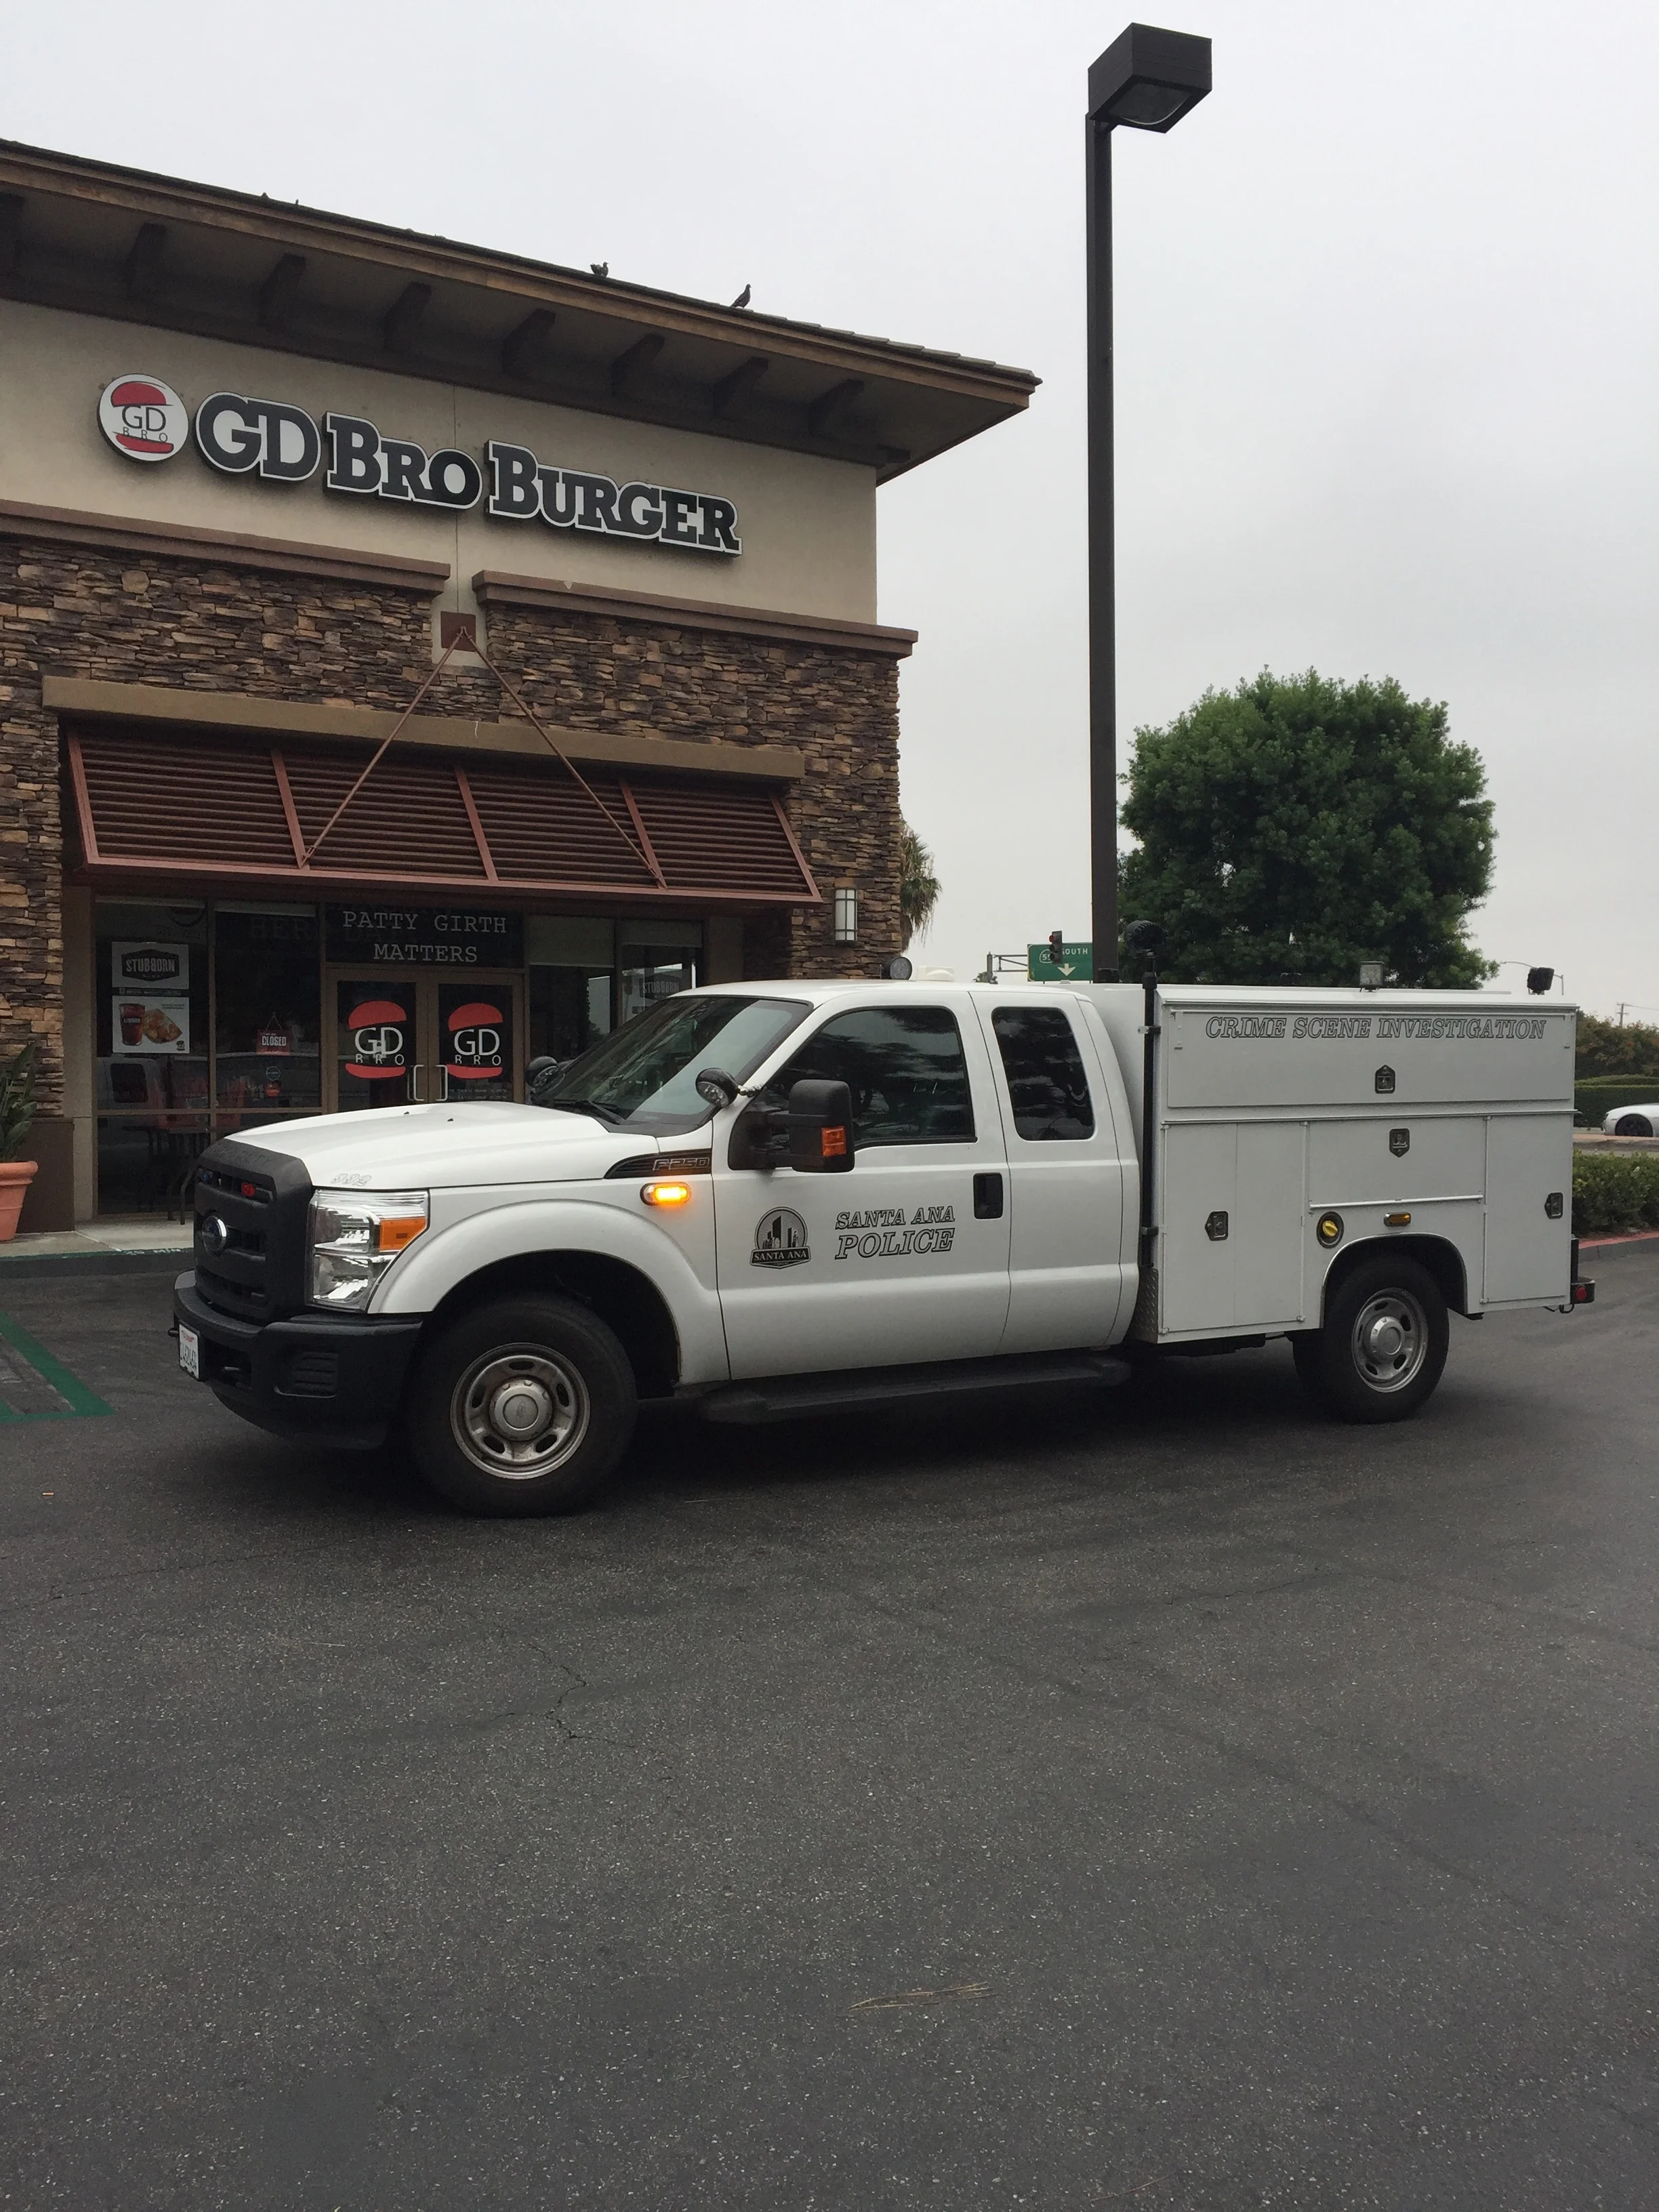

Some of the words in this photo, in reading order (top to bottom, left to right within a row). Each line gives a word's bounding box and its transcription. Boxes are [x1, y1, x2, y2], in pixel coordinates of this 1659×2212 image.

[122, 405, 167, 432] GD
[123, 426, 168, 443] BRO
[195, 392, 321, 481] GD
[343, 911, 418, 930] PATTY
[434, 915, 507, 933] GIRTH
[373, 943, 478, 962] MATTERS
[125, 958, 176, 972] STUBBORN
[1205, 1016, 1287, 1039] CRIME
[1292, 1017, 1372, 1039] SCENE
[1376, 1018, 1547, 1040] INVESTIGATION
[262, 1036, 287, 1046] CLOSED
[354, 1027, 403, 1054] GD
[454, 1029, 500, 1056] GD
[653, 1157, 710, 1171] F-250
[835, 1208, 906, 1230] SANTA
[911, 1206, 956, 1225] ANA
[834, 1227, 955, 1260] POLICE
[754, 1252, 785, 1261] SANTA
[787, 1250, 807, 1258] ANA
